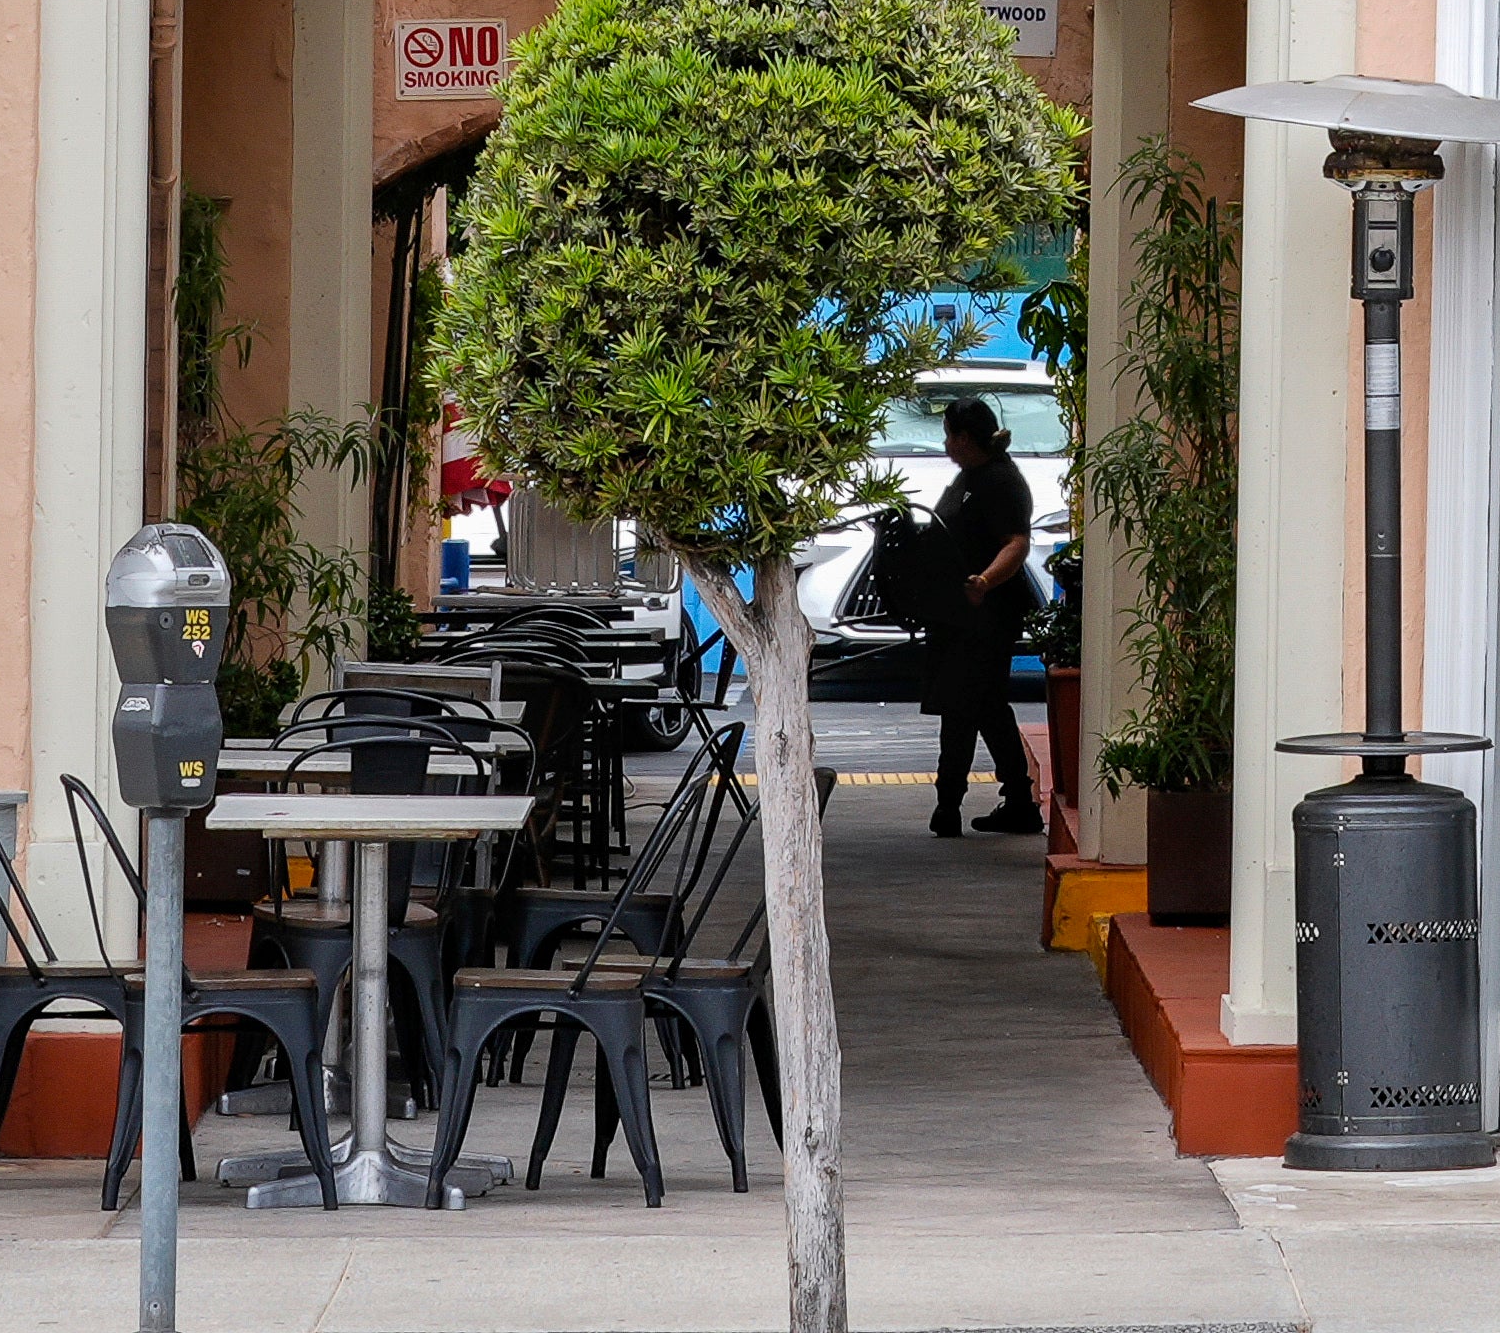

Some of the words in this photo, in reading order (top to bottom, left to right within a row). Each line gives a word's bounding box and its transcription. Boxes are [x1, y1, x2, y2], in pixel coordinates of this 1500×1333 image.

[449, 26, 499, 67] NO
[404, 70, 500, 88] SMOKING
[185, 609, 209, 625] WS
[182, 626, 211, 640] 252
[179, 761, 204, 777] WS
